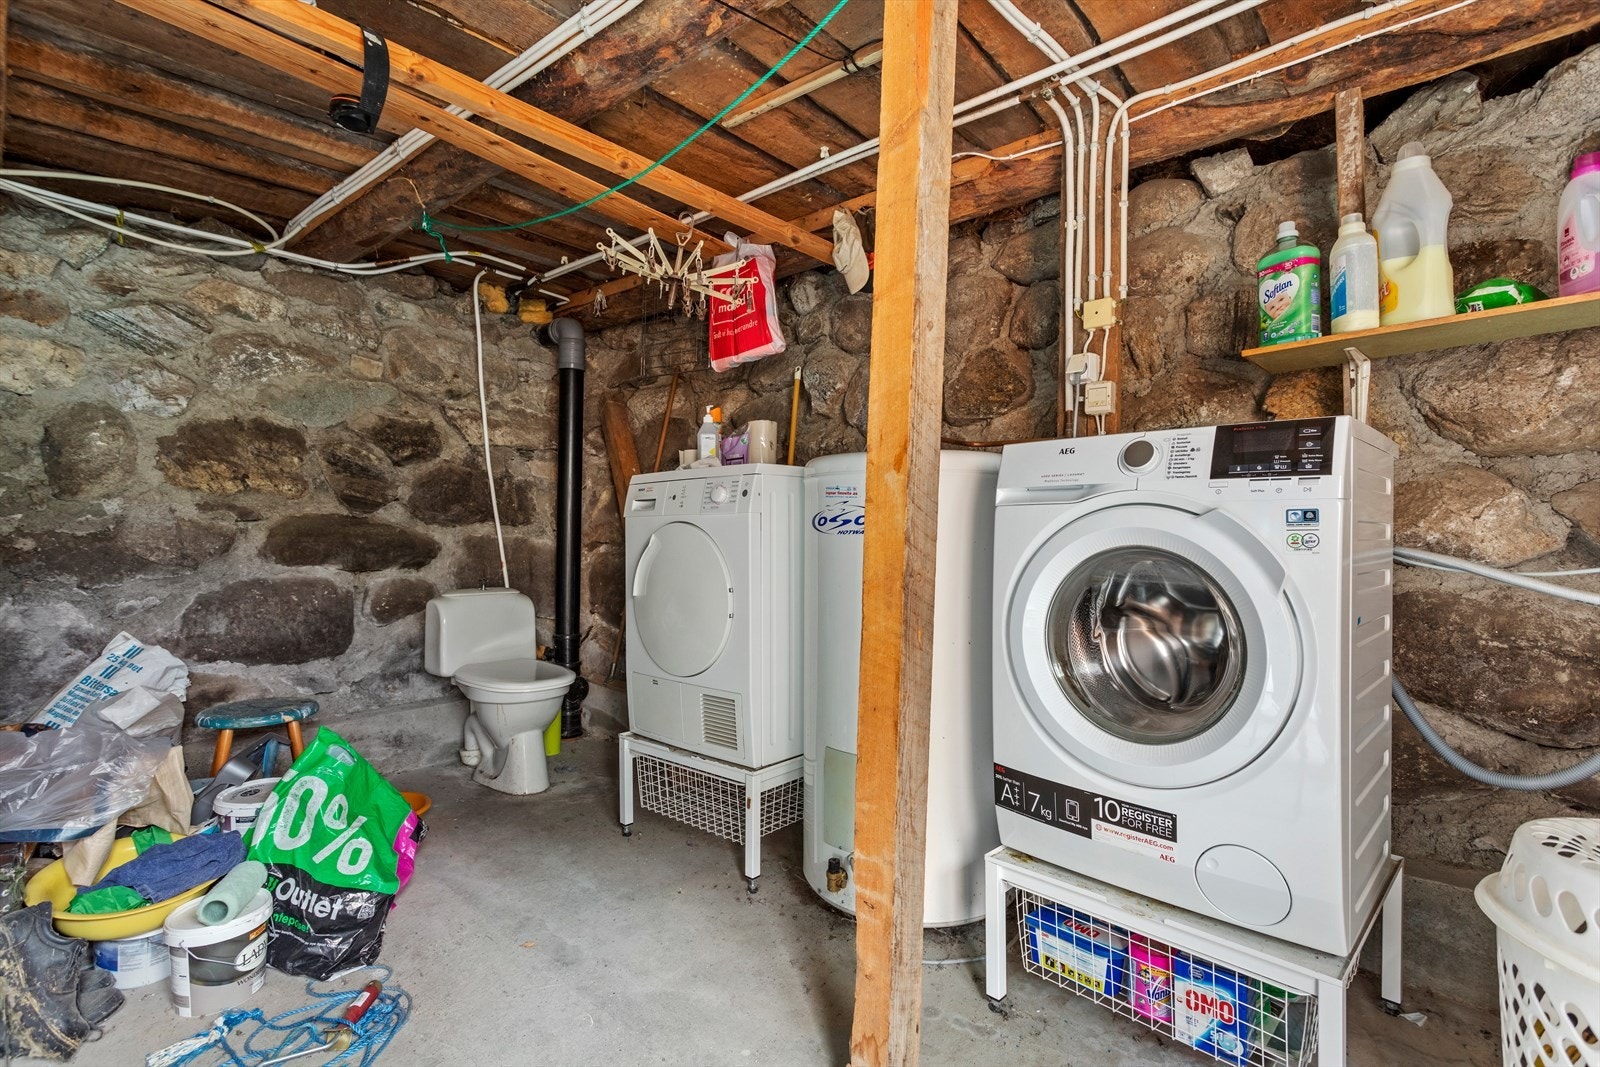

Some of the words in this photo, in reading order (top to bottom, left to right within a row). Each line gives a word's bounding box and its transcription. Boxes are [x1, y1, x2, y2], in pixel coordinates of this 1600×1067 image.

[1264, 280, 1293, 304] Softlan
[1059, 447, 1075, 455] AEG
[106, 653, 118, 663] 25
[127, 662, 144, 673] net
[80, 675, 119, 697] Bittersa
[1028, 791, 1040, 812] 7
[1040, 805, 1052, 820] kg
[1094, 797, 1120, 822] 10
[1122, 807, 1173, 829] REGISTER
[1122, 816, 1142, 830] FOR
[1146, 823, 1172, 838] FREE
[1104, 827, 1174, 851] www.registerAEG.com
[1160, 854, 1175, 863] AEG
[275, 878, 344, 920] Outlet
[273, 912, 310, 933] ntepose!
[1185, 989, 1235, 1025] OMO
